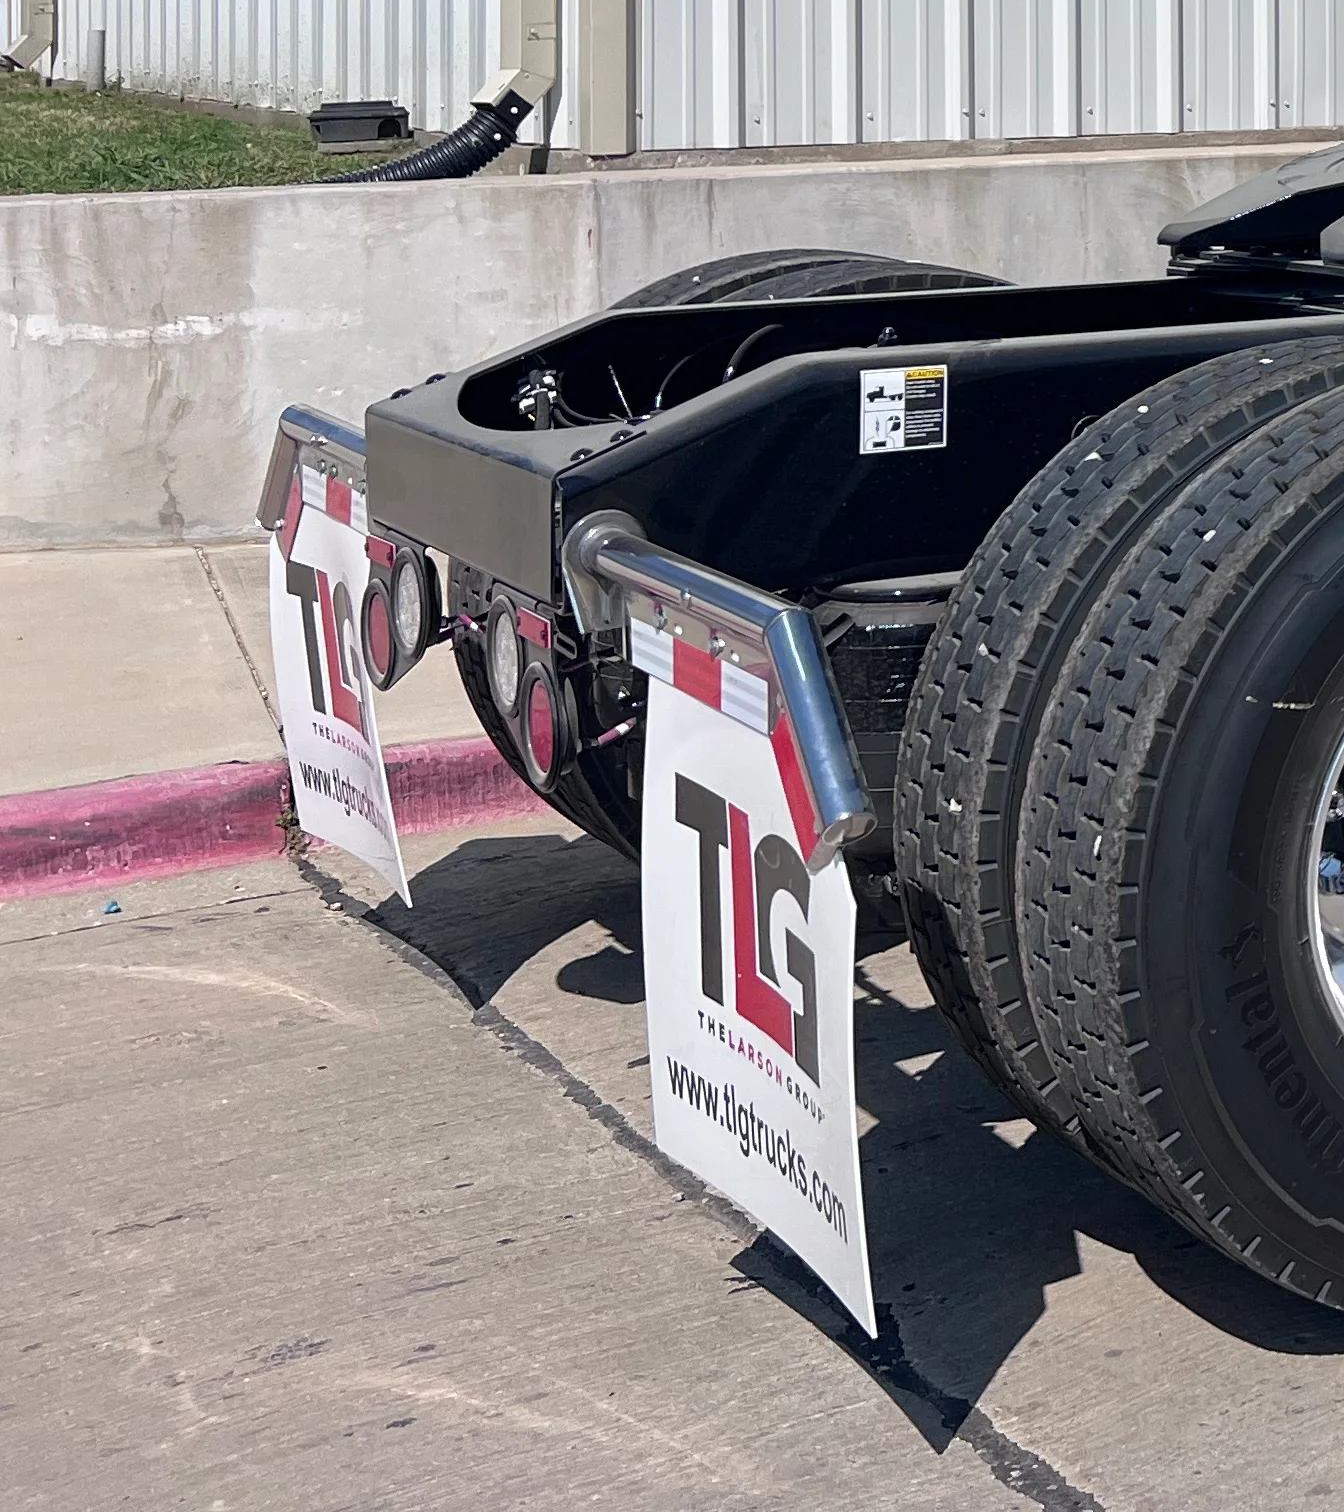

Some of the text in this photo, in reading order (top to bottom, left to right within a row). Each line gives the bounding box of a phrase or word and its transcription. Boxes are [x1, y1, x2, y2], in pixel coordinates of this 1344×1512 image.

[286, 560, 372, 747] TLG
[674, 771, 821, 1089] TLG
[666, 1055, 848, 1245] www.tlgtrucks.com
